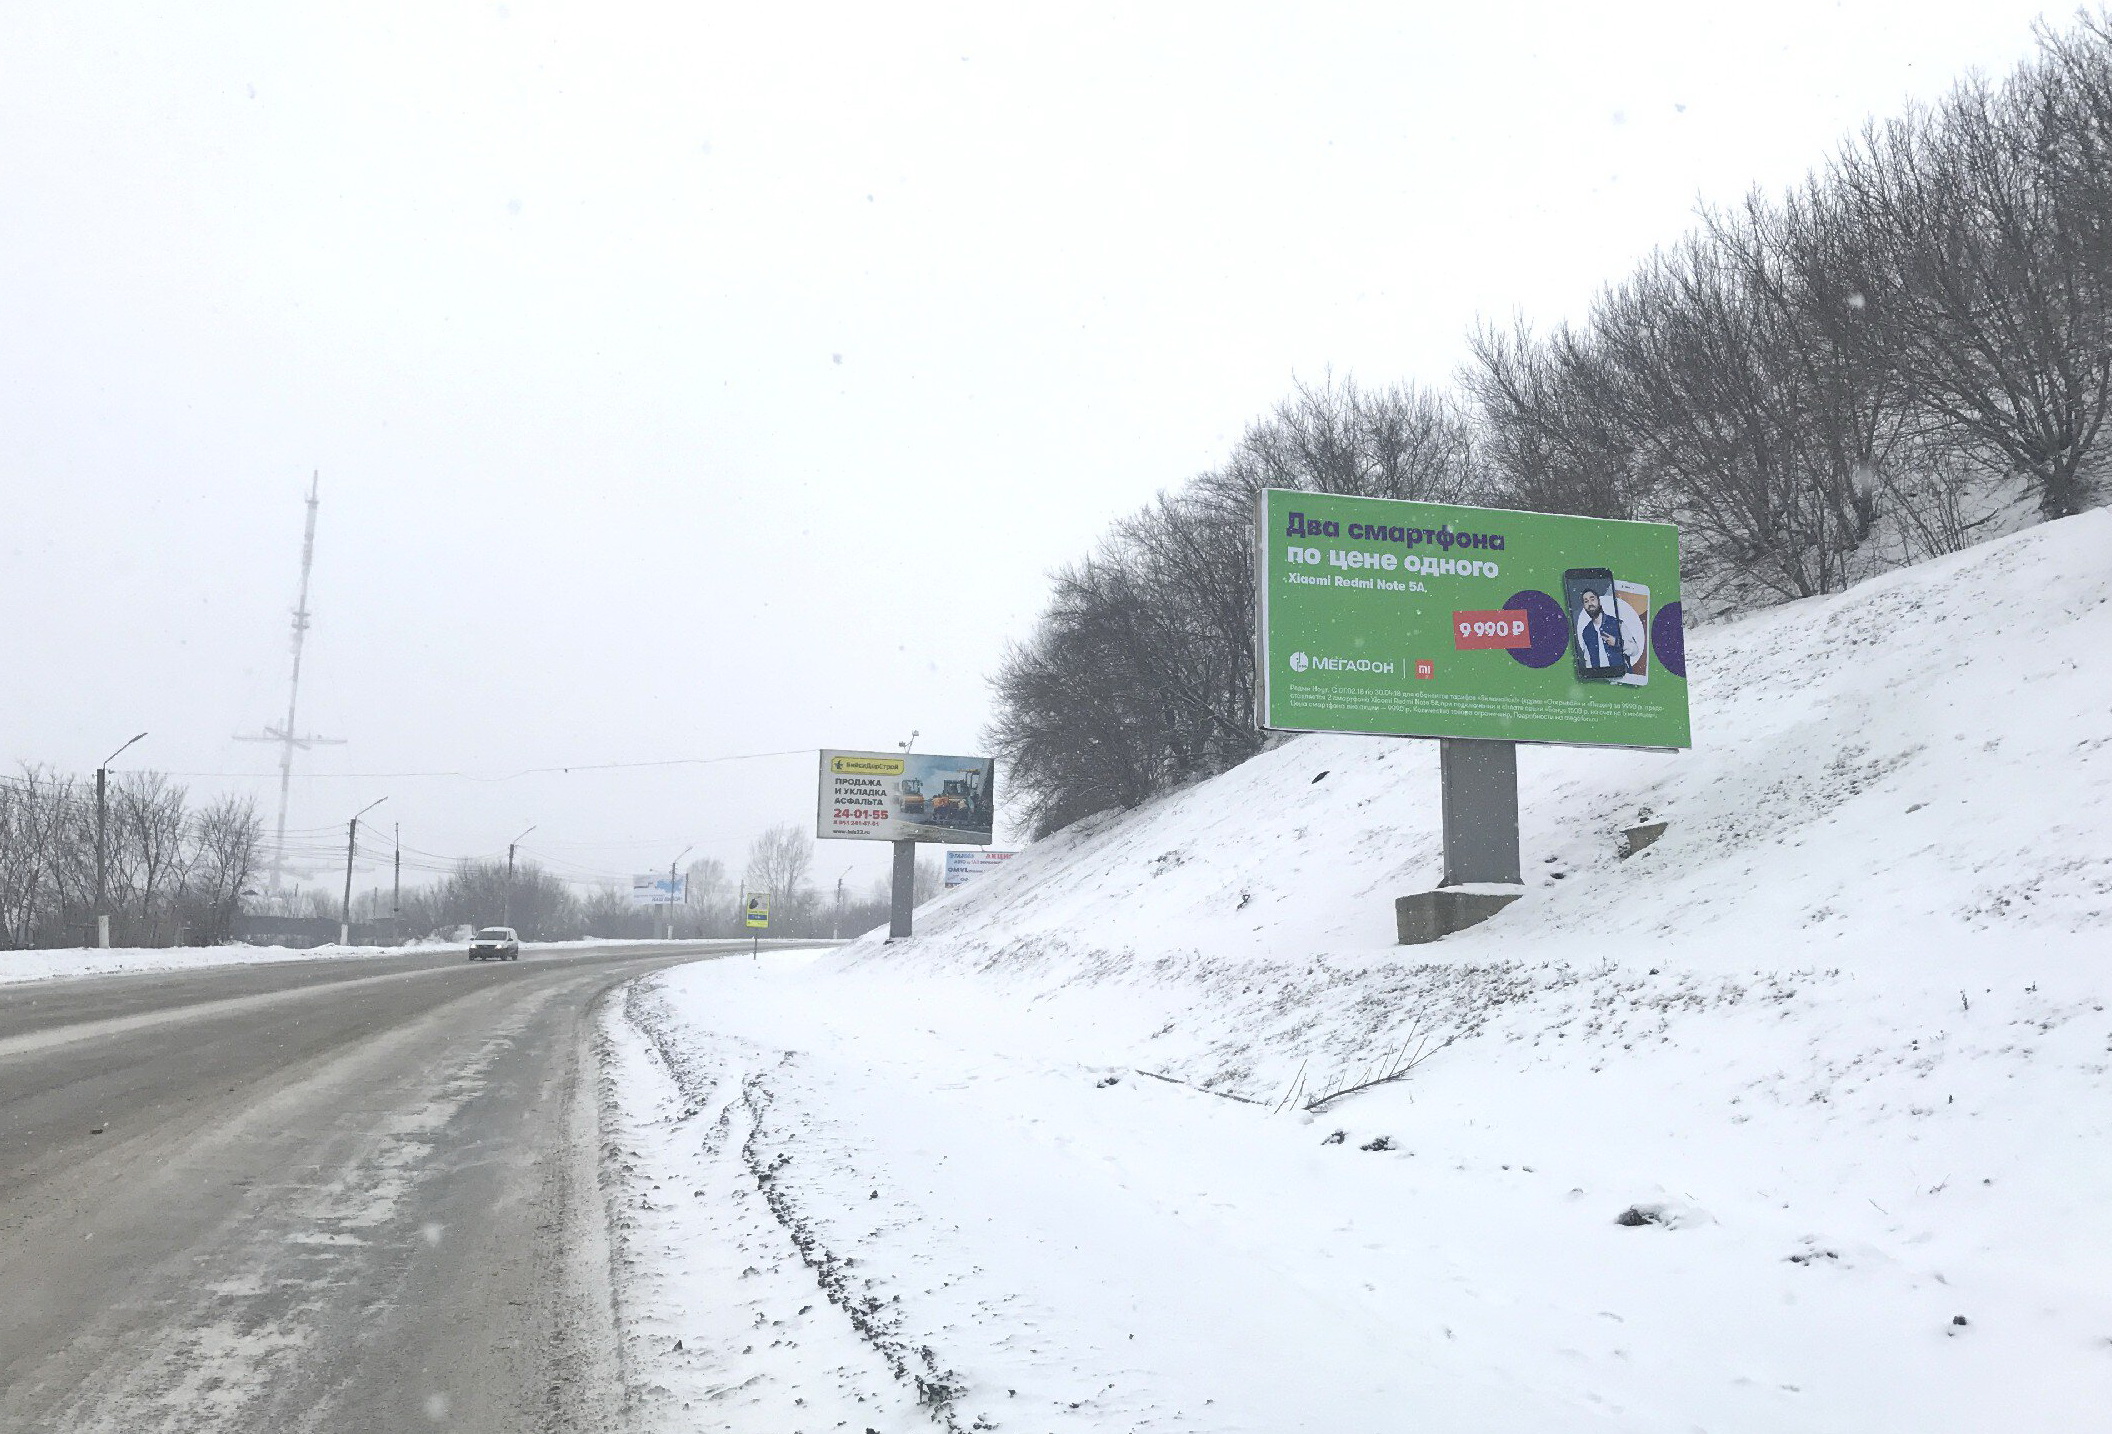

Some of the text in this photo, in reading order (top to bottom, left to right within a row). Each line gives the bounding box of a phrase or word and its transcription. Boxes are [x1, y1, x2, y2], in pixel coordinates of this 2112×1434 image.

[1286, 511, 1505, 551] Два смартфона
[1287, 546, 1499, 578] по цене одного
[1289, 573, 1331, 586] Xiaomi
[1335, 576, 1374, 589] Redmi
[1377, 578, 1405, 591] Note
[835, 778, 882, 786] ПРОДАЖА
[844, 788, 887, 796] УКЛАДКА
[834, 797, 883, 805] АСФАЛЬТА
[834, 808, 888, 820] 24-01-55
